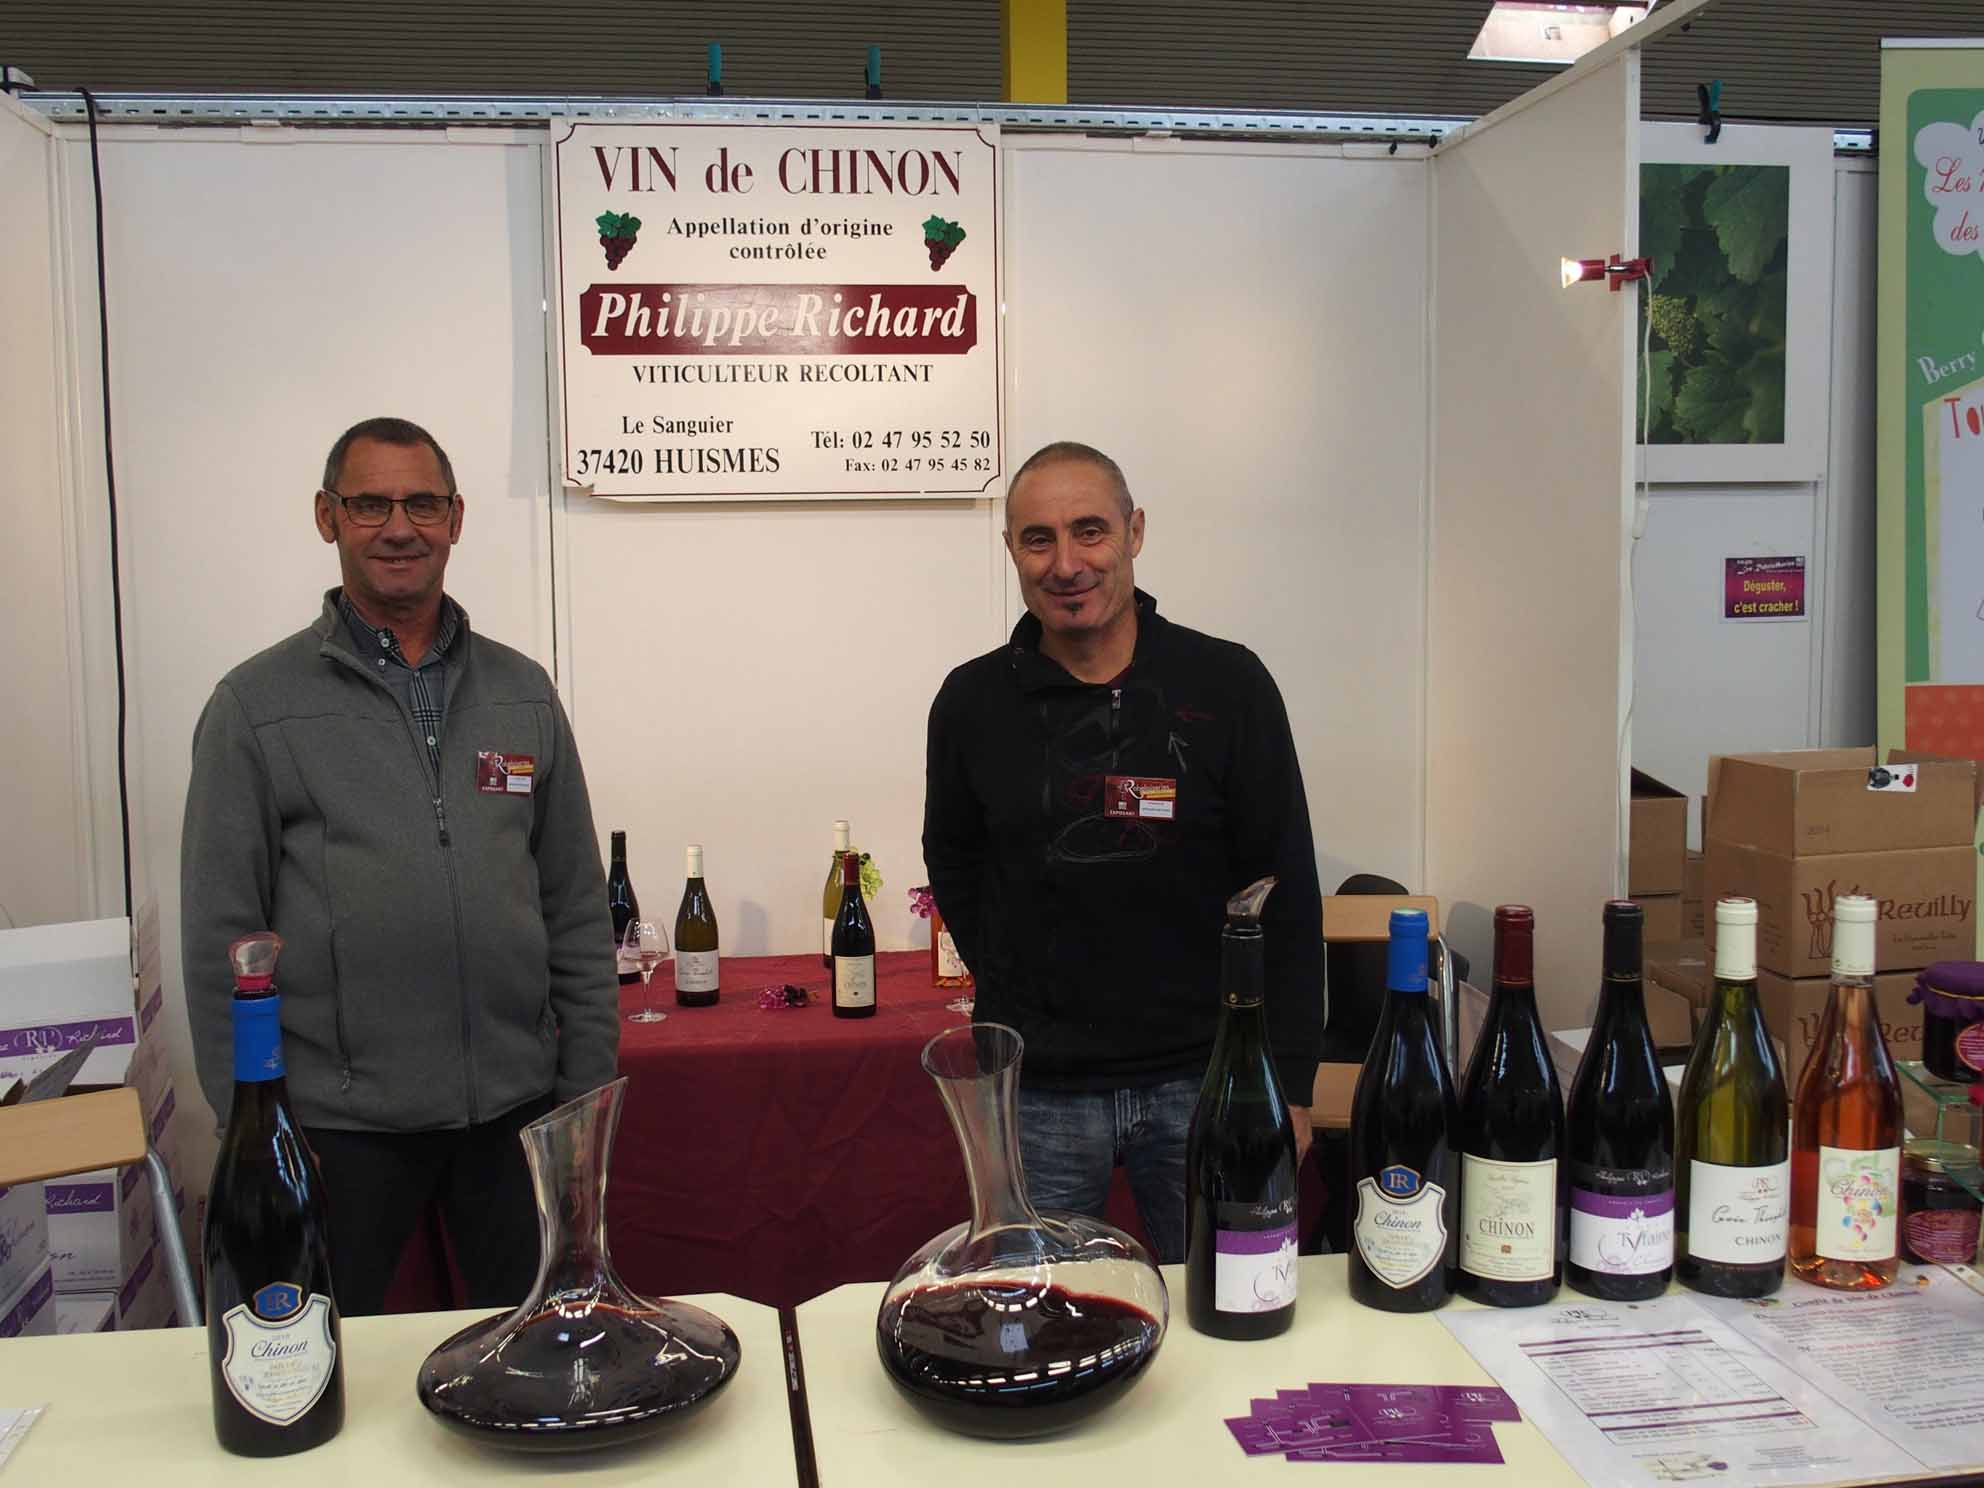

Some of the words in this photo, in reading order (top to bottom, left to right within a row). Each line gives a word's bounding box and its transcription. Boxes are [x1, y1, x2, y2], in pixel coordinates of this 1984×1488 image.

[591, 146, 680, 192] VIN
[705, 147, 753, 193] de
[778, 147, 963, 195] CHINON
[1932, 156, 1971, 193] Les
[667, 217, 789, 239] Appellation
[800, 217, 893, 239] d'origine
[1950, 208, 1979, 241] des
[729, 241, 827, 260] contrôlée
[591, 292, 779, 346] Philippe
[792, 292, 969, 338] Richard
[632, 364, 789, 383] VITICULTEUR
[800, 364, 934, 383] RECOLTANT
[1917, 351, 1976, 384] Berry
[622, 416, 647, 435] Le
[652, 416, 734, 437] Sanguier
[811, 431, 844, 449] Tél:
[852, 431, 873, 449] 02
[882, 431, 902, 449] 47
[911, 431, 932, 449] 95
[940, 431, 961, 449] 52
[970, 431, 990, 449] 50
[577, 449, 642, 474] 37420
[655, 447, 780, 474] HUISMES
[845, 458, 876, 472] Fax:
[881, 458, 899, 472] 02
[905, 458, 922, 472] 47
[928, 458, 945, 472] 95
[951, 458, 968, 472] 45
[974, 458, 990, 472] 82
[1759, 600, 1794, 613] cracher
[1877, 893, 1972, 922] Reuilly
[1374, 1210, 1422, 1231] Chinon
[1479, 1217, 1536, 1237] CHINON
[251, 1339, 309, 1359] Chinon
